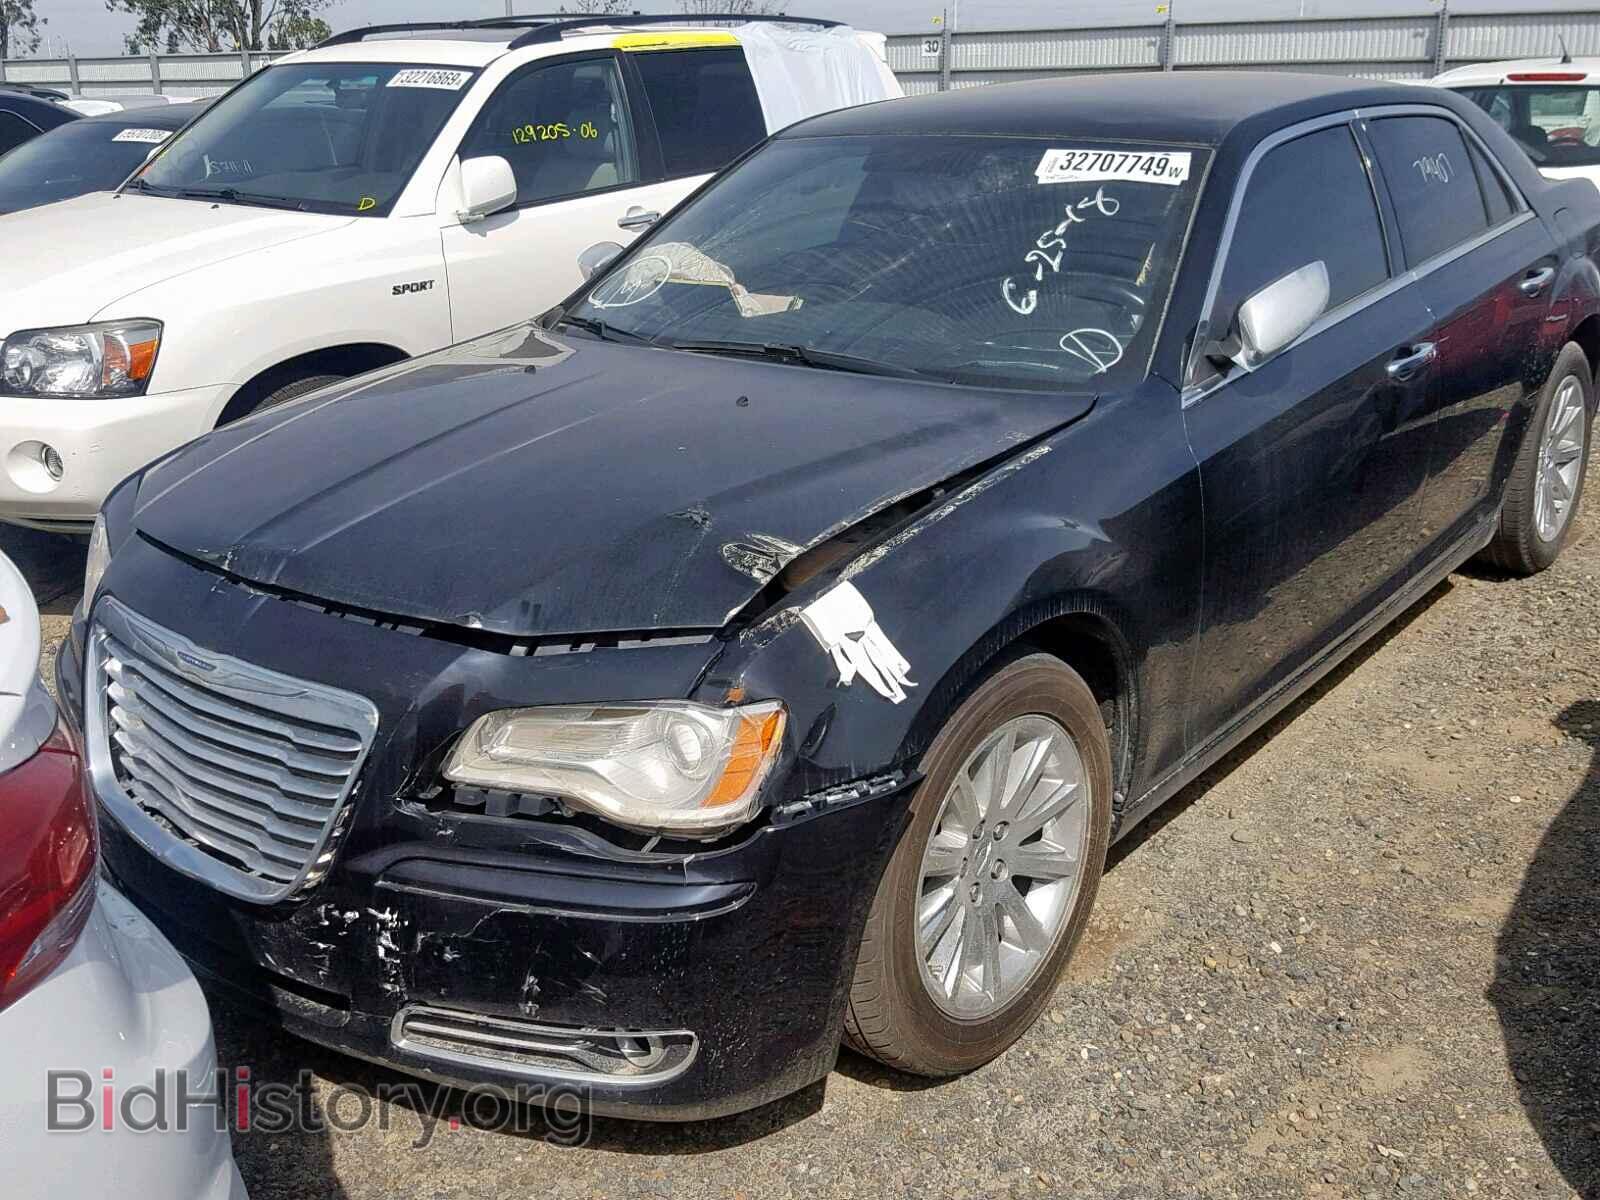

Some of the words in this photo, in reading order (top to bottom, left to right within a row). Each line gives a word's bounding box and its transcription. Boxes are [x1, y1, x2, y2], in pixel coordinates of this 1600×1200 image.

[925, 40, 939, 53] 30
[357, 197, 376, 211] D
[391, 279, 436, 295] SPORT
